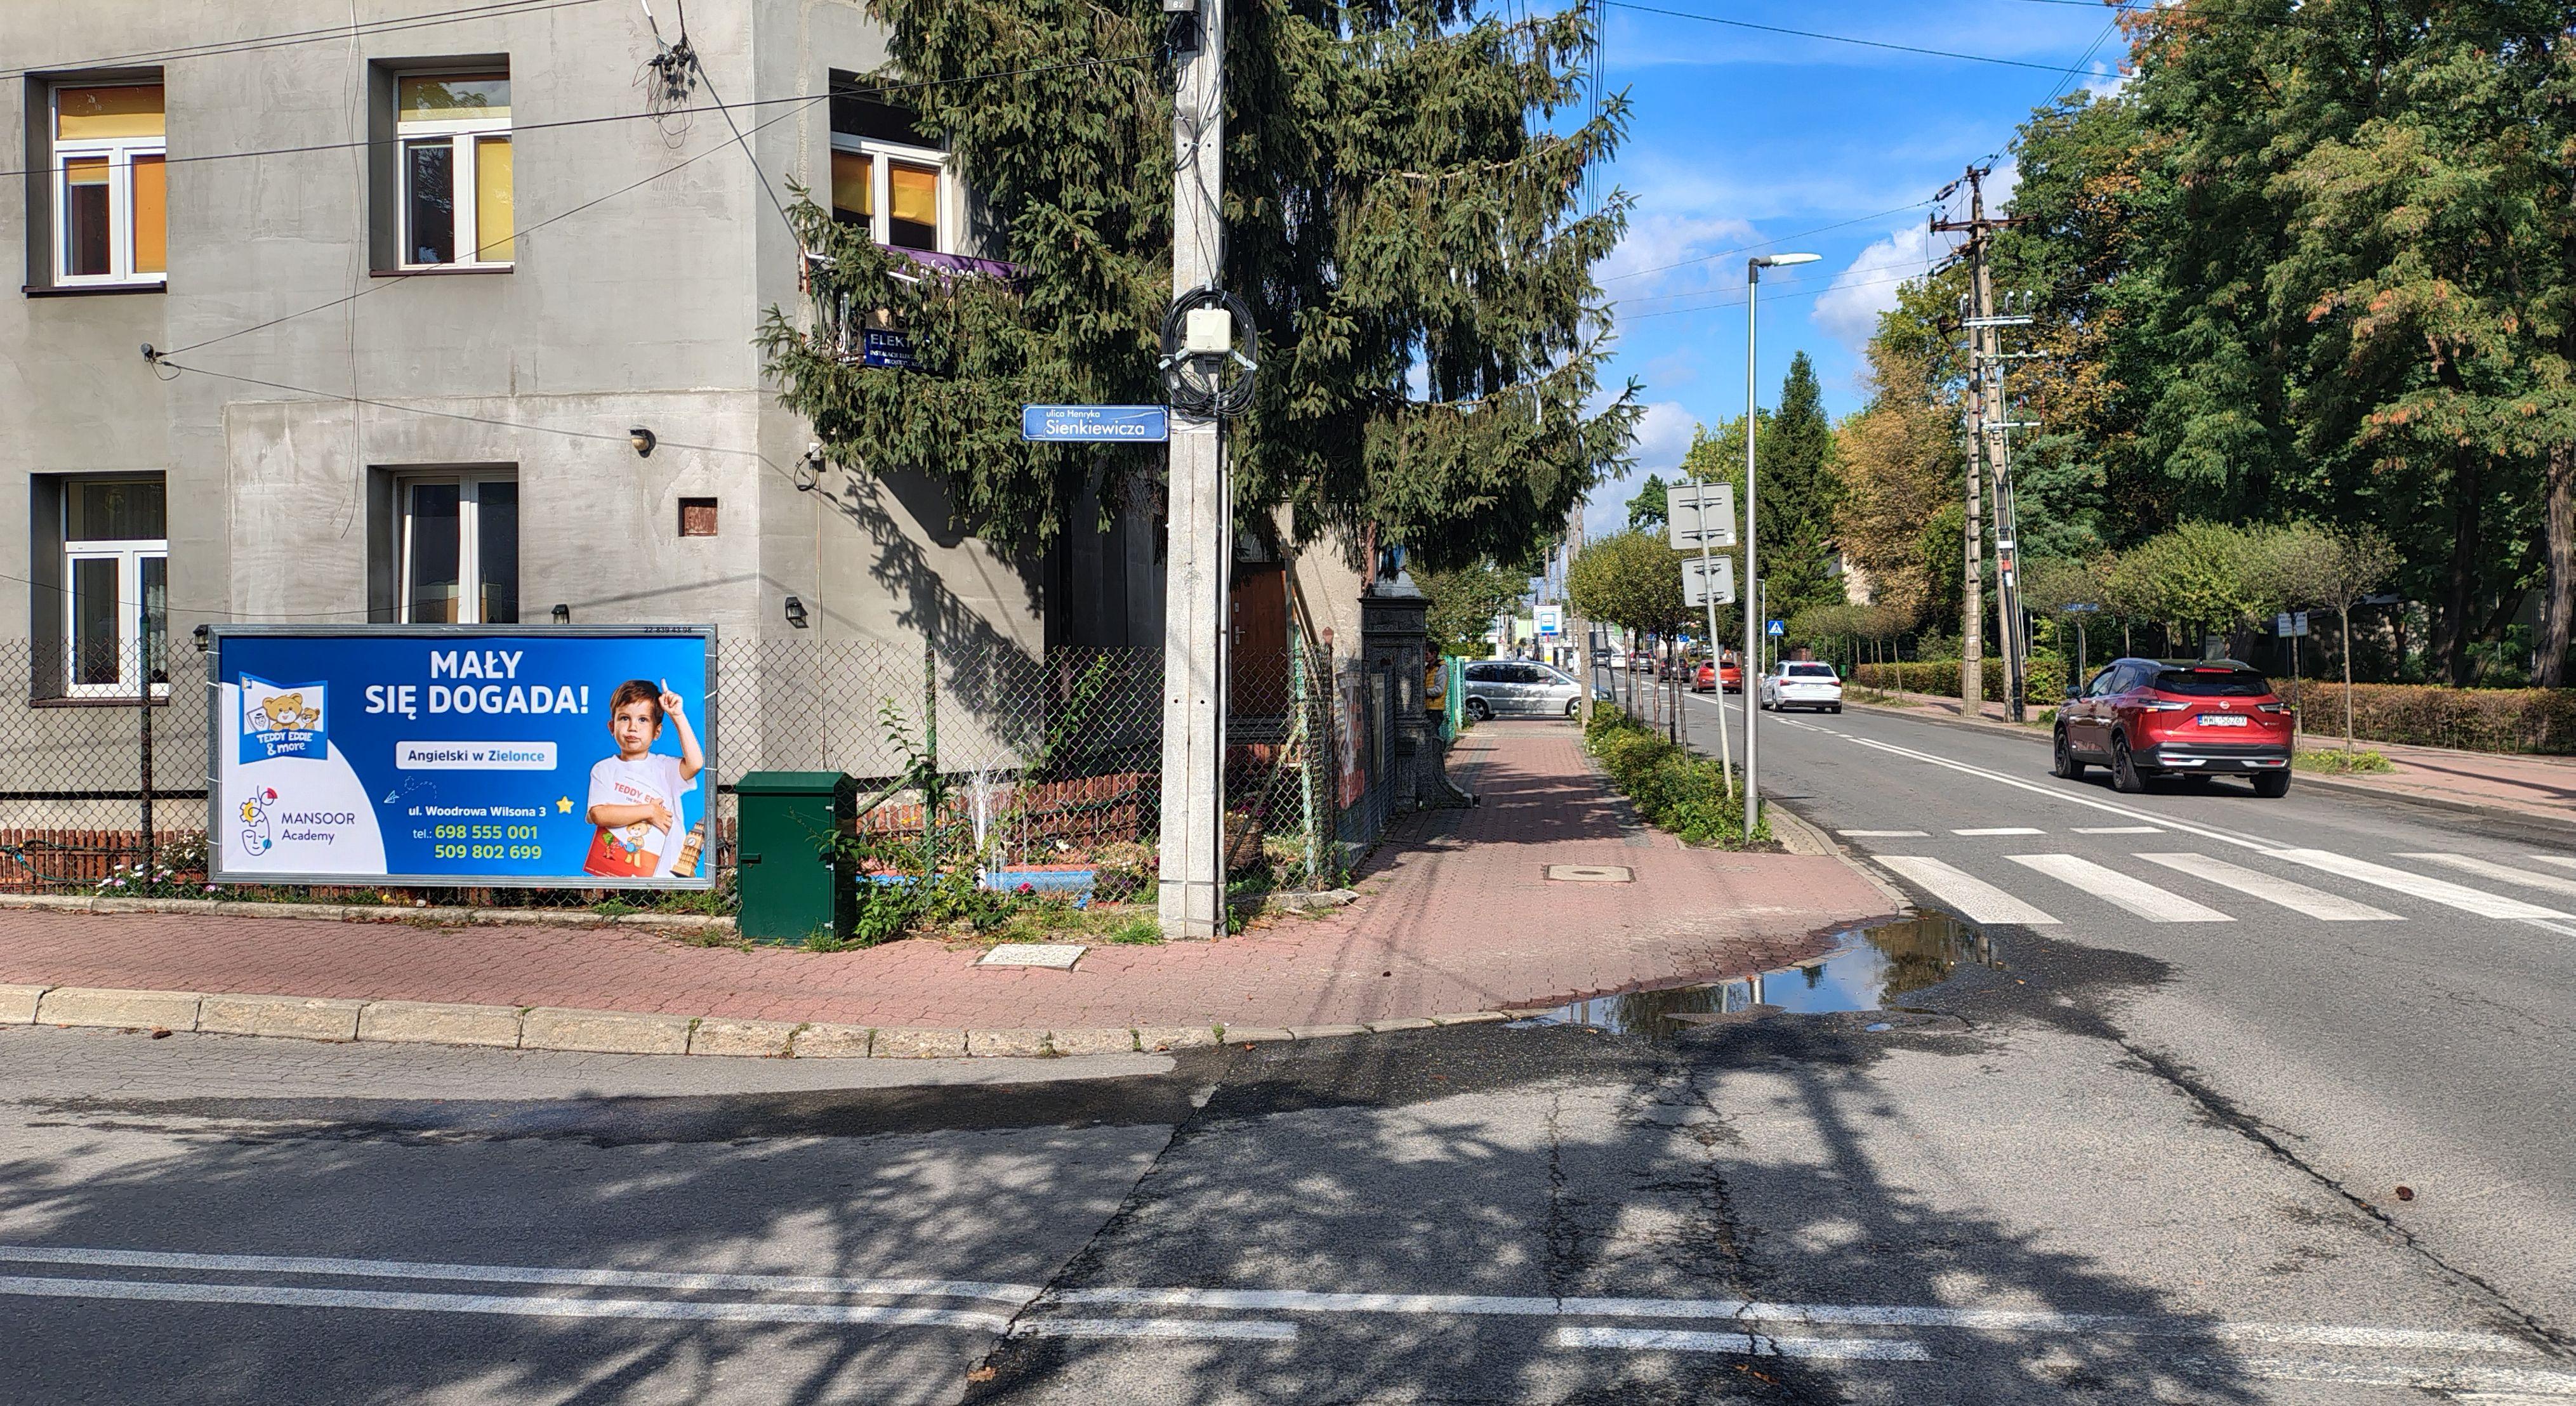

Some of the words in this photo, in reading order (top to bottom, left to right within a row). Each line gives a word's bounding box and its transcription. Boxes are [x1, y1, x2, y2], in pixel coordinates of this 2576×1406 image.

[1046, 409, 1064, 417] ulica
[1067, 410, 1100, 419] Henryka
[1046, 419, 1145, 435] Sienkiewicza
[431, 650, 524, 679] MAŁY
[365, 685, 417, 720] SIĘ
[428, 685, 589, 714] DOGADA!
[256, 732, 286, 744] TEDDY
[288, 732, 314, 742] EDDIE
[267, 743, 276, 756] &
[277, 742, 305, 753] more
[407, 749, 468, 762] Angielski
[473, 752, 484, 761] w
[488, 750, 545, 761] Zielonce
[614, 782, 643, 798] TEDDY
[281, 813, 355, 824] MANSOOR
[408, 806, 422, 816] ul.
[425, 806, 487, 816] Woodrowa
[490, 806, 536, 817] Wilsona
[539, 807, 546, 817] 3
[282, 829, 335, 845] Academy
[413, 829, 432, 839] tel.:
[435, 825, 467, 839] 698
[472, 825, 502, 839] 555
[507, 825, 538, 839] 001
[435, 844, 467, 858] 509
[472, 844, 504, 858] 802
[509, 845, 542, 859] 699
